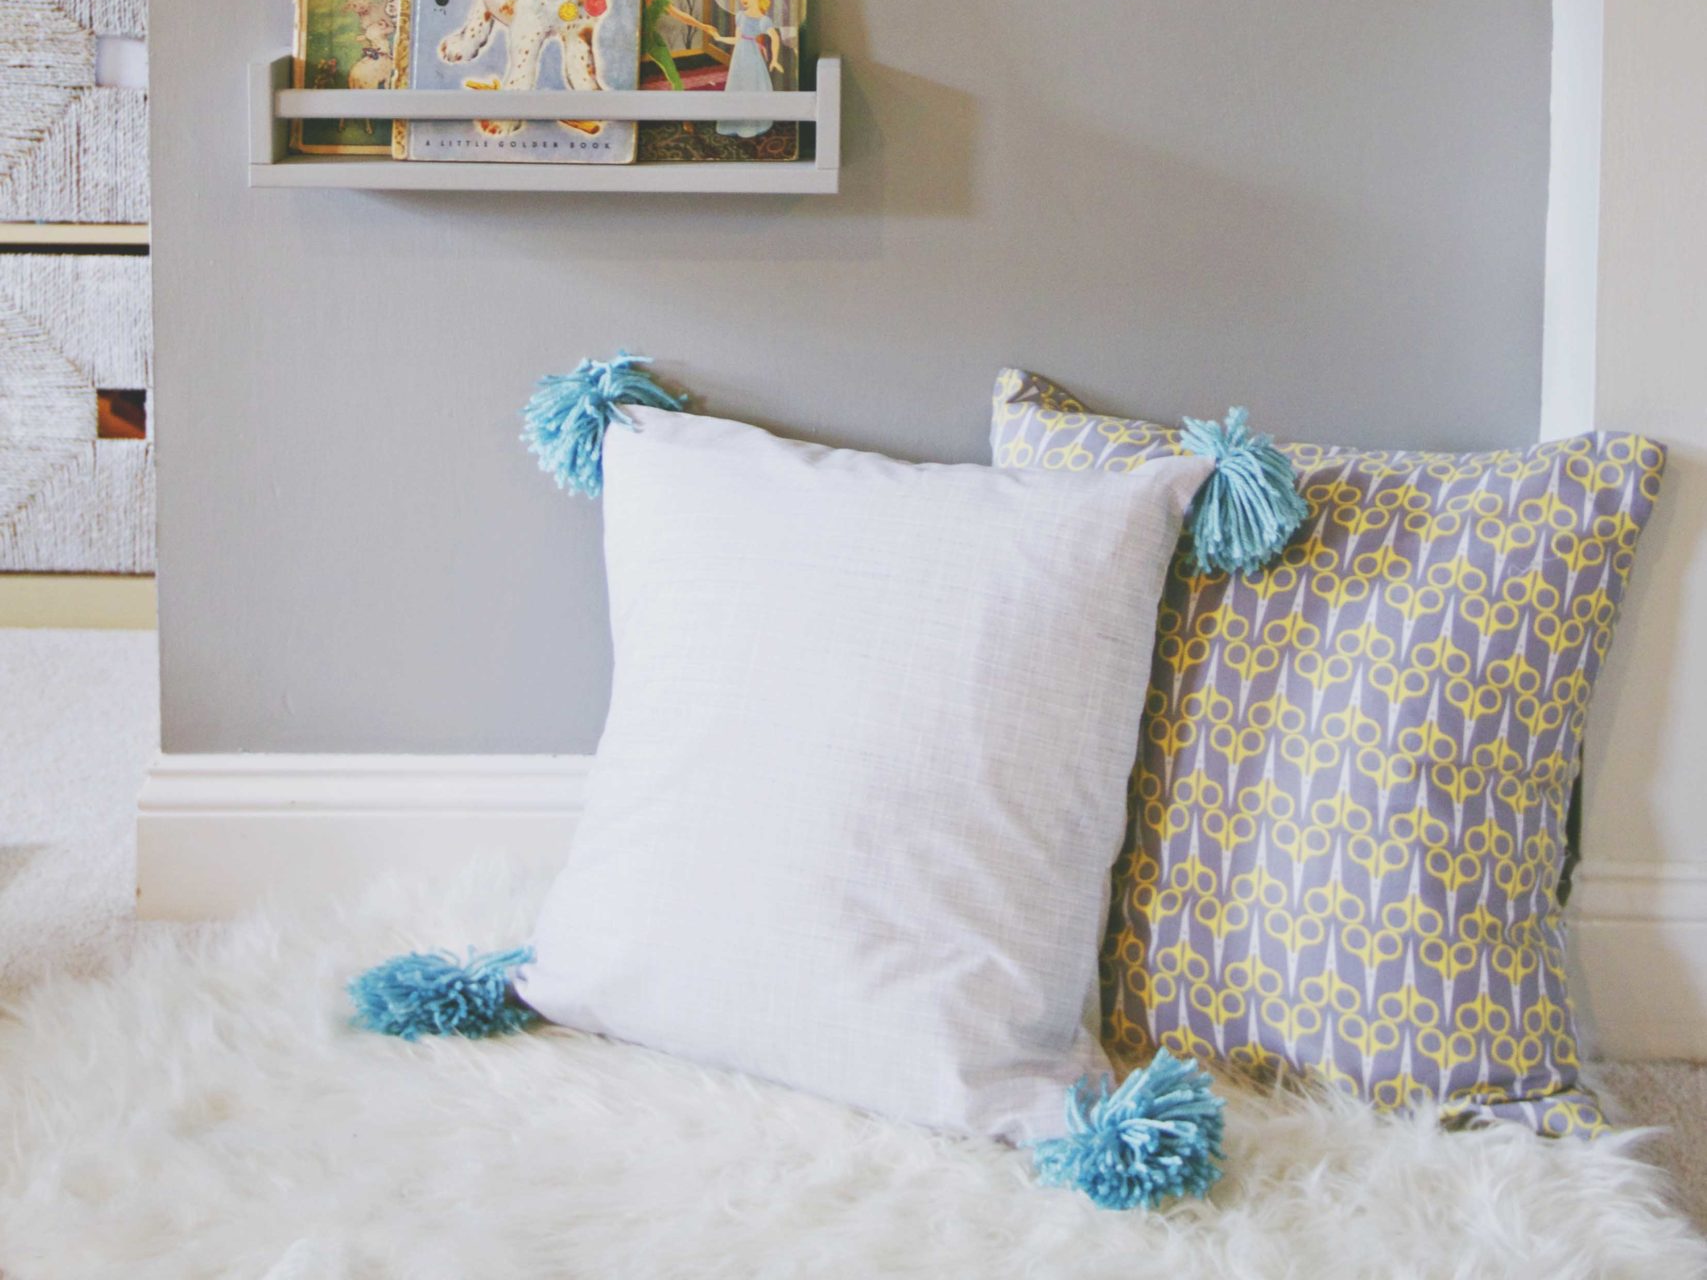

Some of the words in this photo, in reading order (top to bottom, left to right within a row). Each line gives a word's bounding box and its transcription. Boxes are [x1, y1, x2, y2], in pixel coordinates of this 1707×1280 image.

[440, 140, 489, 148] LITTLE
[498, 140, 559, 149] GOLDEN
[570, 141, 611, 150] BOOK
